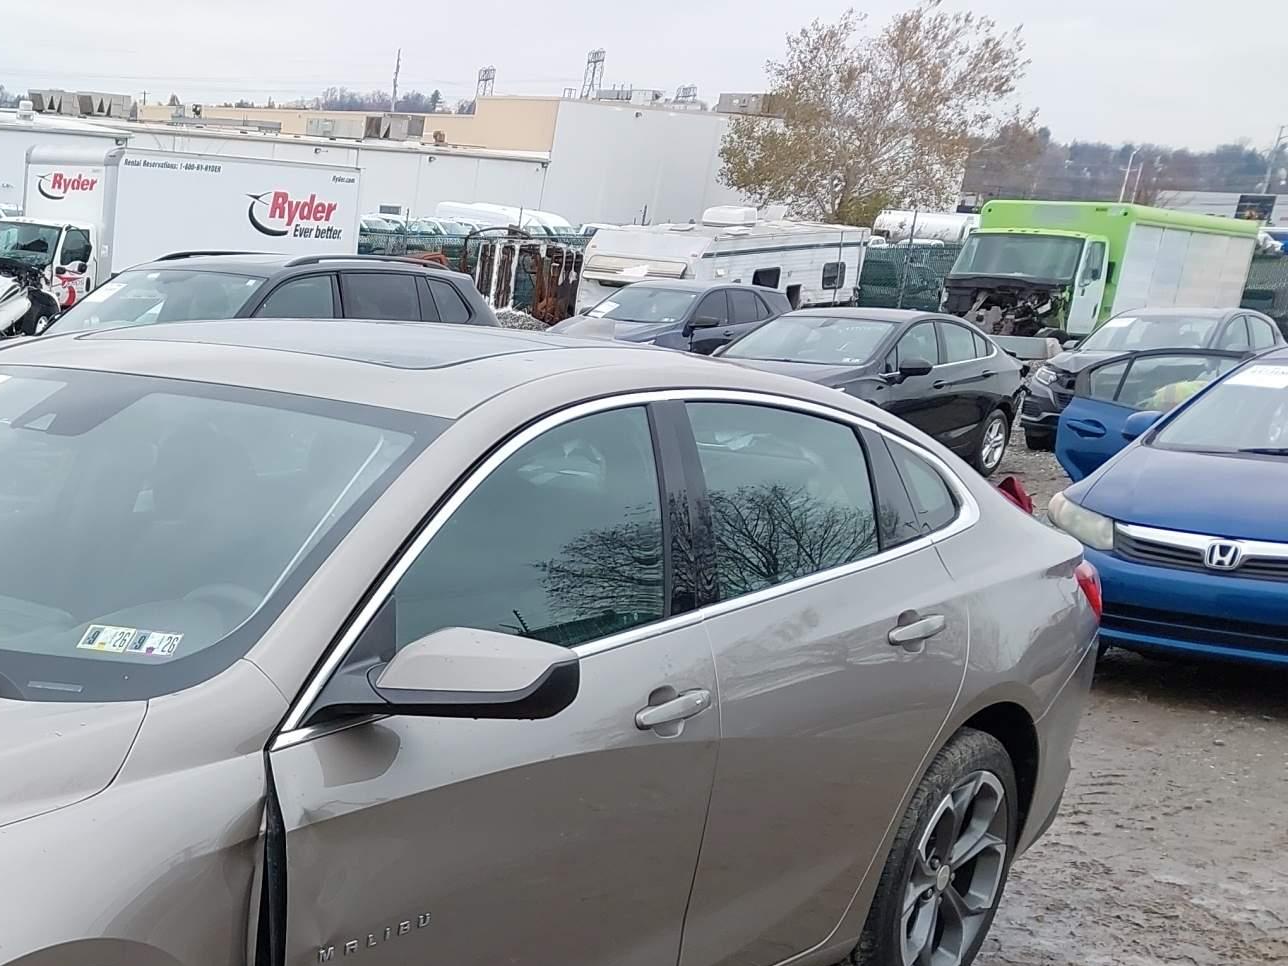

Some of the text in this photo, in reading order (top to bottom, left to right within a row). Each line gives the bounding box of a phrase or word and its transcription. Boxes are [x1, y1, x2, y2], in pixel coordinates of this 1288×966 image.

[124, 159, 142, 167] Rental
[52, 173, 98, 194] Ryder
[269, 191, 338, 227] Ryder
[293, 223, 343, 241] Ever better.
[318, 911, 431, 963] MALIBU
